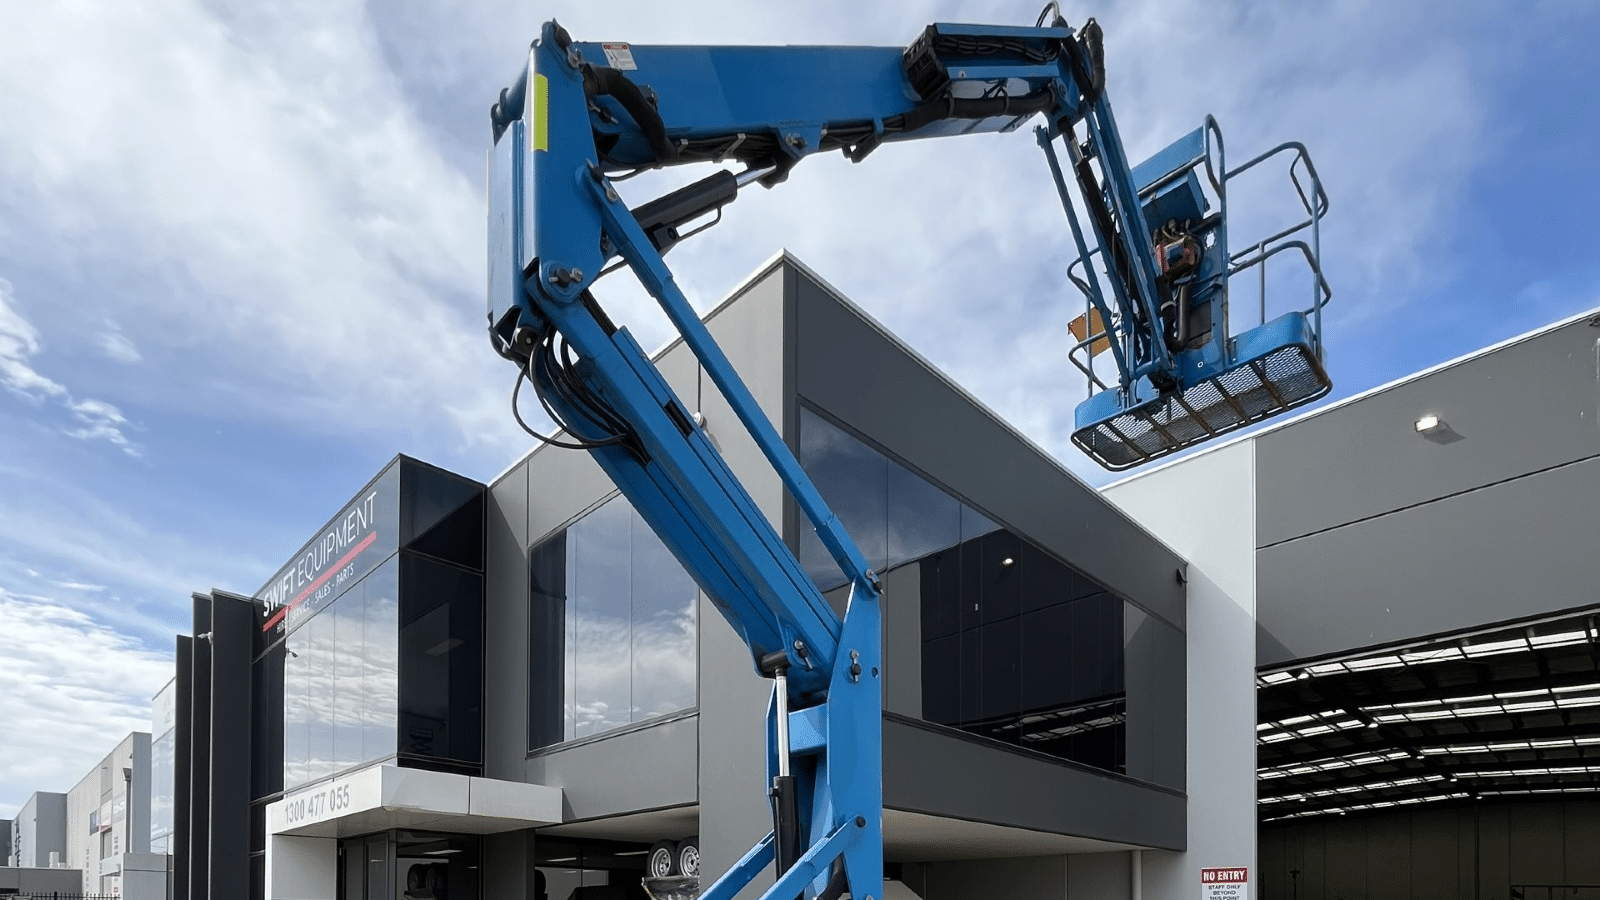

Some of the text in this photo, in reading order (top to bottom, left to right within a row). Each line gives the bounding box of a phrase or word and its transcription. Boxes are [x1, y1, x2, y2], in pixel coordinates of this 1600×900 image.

[263, 491, 377, 617] SWIFT EQUIPMENT
[315, 582, 331, 604] SALES
[336, 563, 354, 587] PARTS
[285, 784, 350, 824] 1300 477 055
[1203, 870, 1246, 881] NO ENTRY
